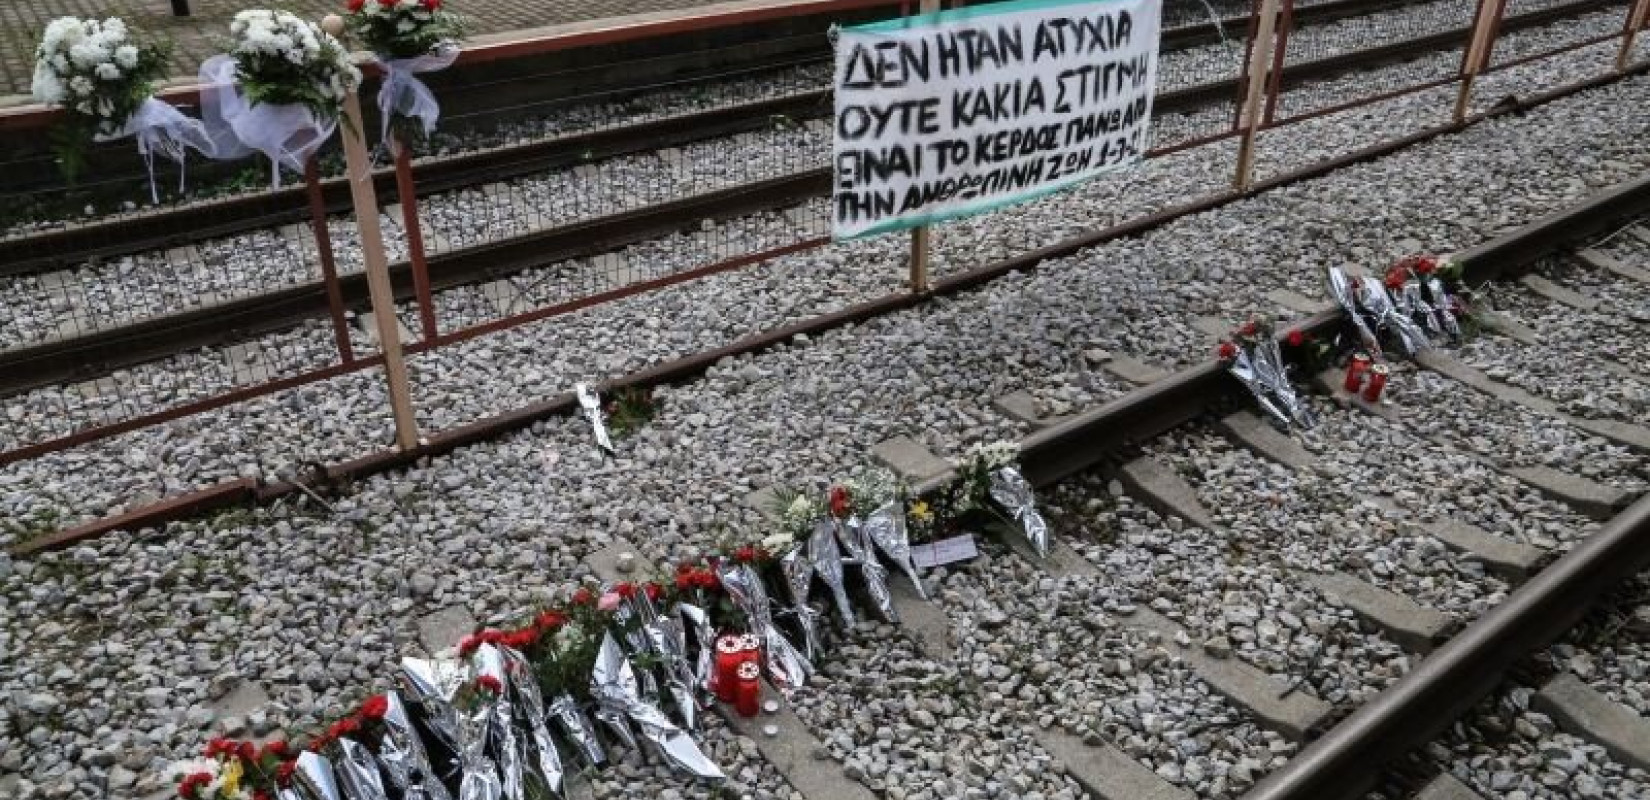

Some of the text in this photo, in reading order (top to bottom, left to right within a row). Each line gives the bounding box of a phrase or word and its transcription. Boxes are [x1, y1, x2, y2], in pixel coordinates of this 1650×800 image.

[842, 10, 1132, 89] ΔΕΝ ΗΤΑΝ ΑΤΥΧΙΑ
[838, 97, 941, 140] ΟΥΤΕ
[951, 76, 1046, 129] ΚΑΚΙΑ
[926, 139, 969, 175] ΤΟ
[973, 122, 1062, 167] ΚΕΡΔΟΣ
